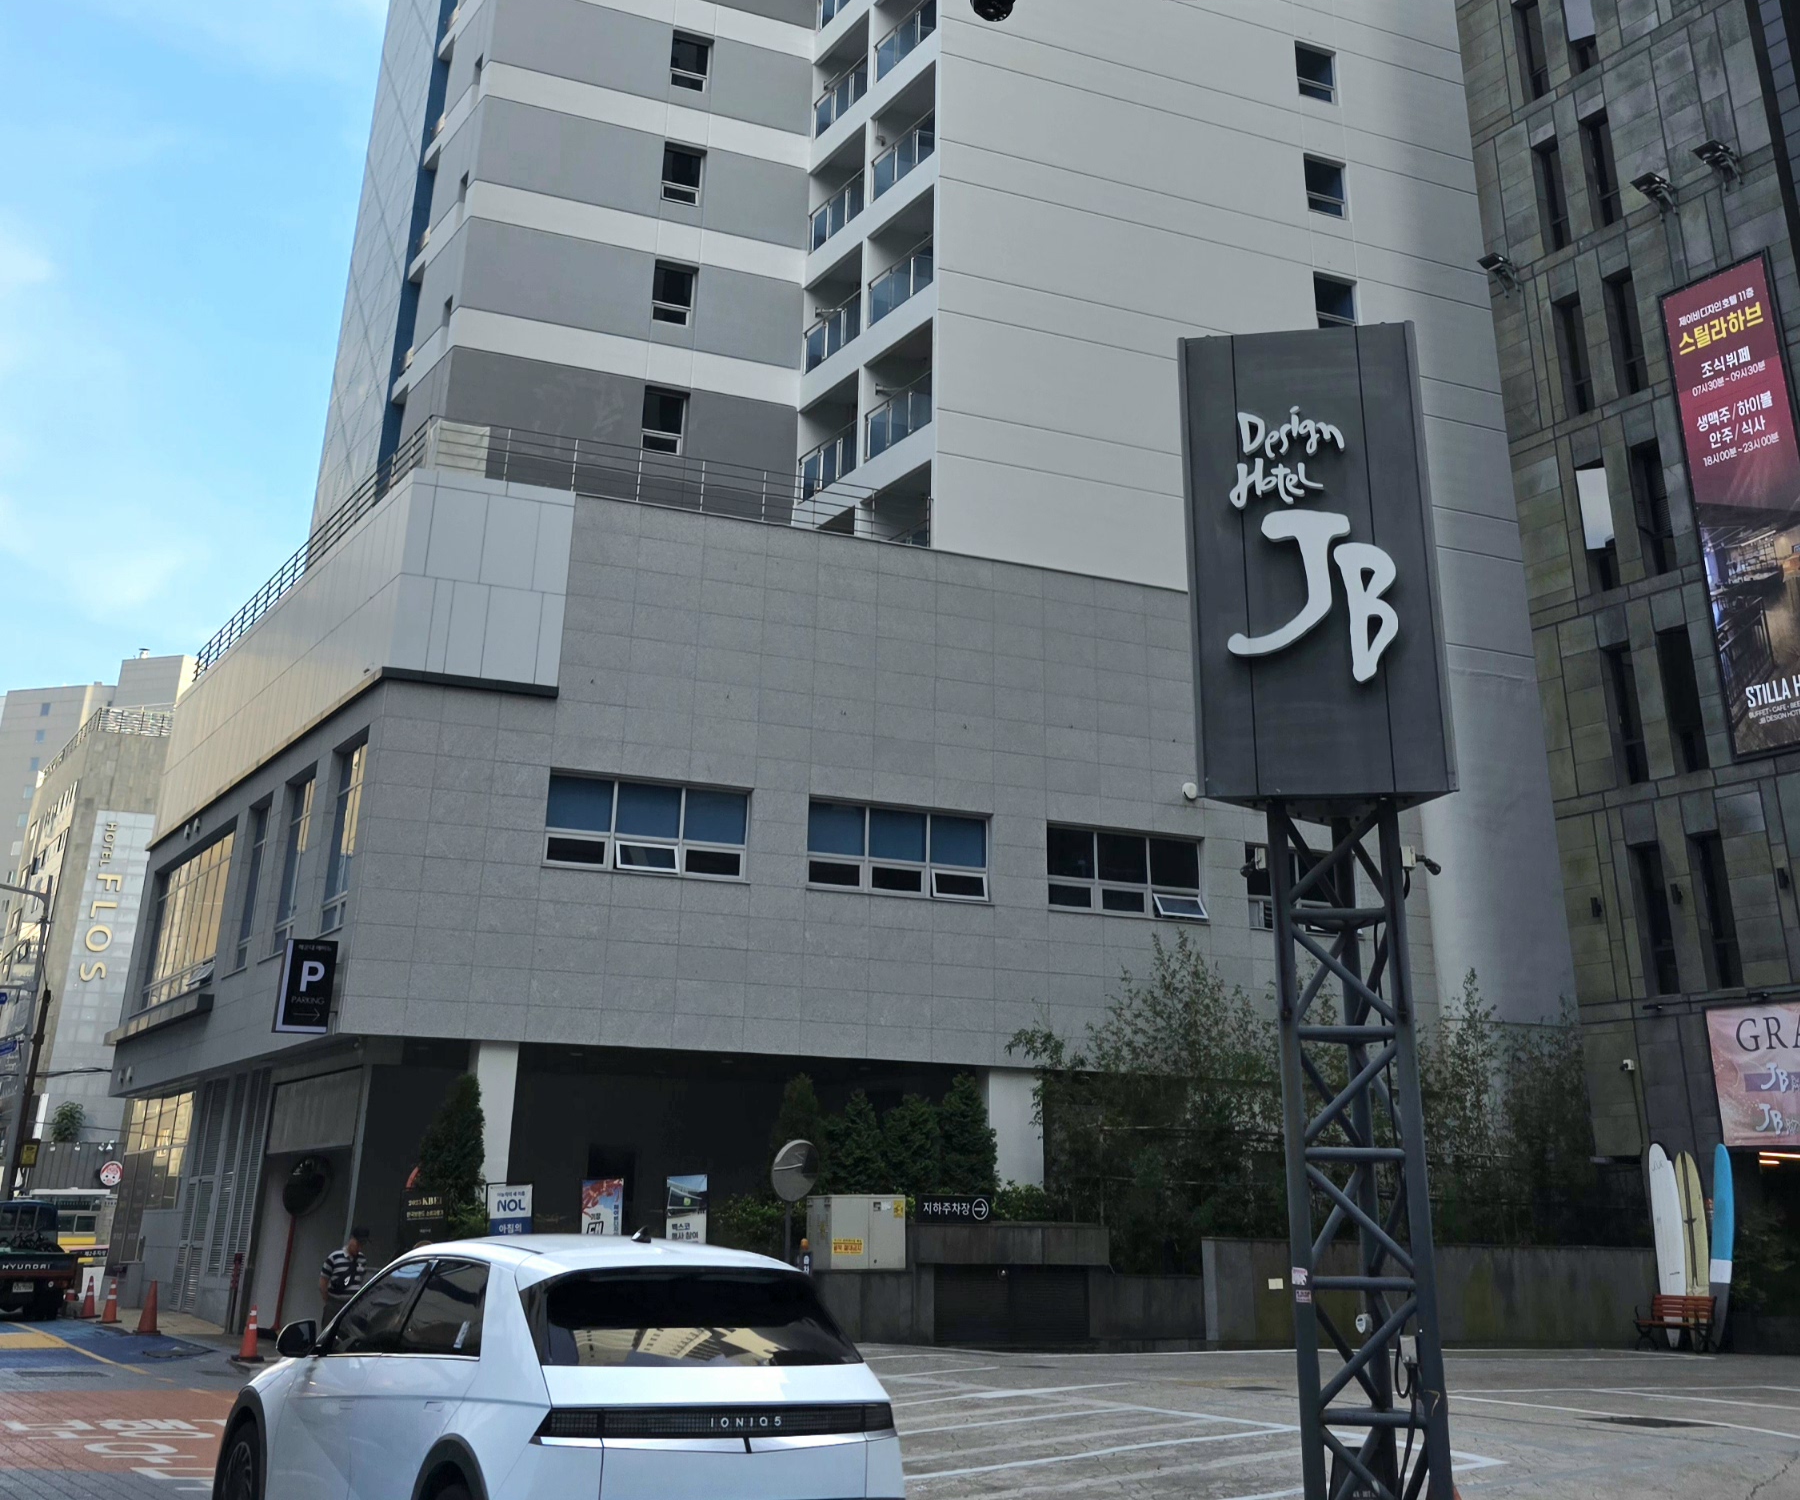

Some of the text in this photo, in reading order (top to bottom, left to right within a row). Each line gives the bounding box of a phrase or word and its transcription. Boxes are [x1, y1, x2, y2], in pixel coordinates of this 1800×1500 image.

[1679, 301, 1764, 355] 스틸라하브
[1237, 406, 1345, 459] Design
[1229, 457, 1325, 510] Hotel
[1227, 508, 1398, 683] JB
[1745, 677, 1791, 708] STILLA
[80, 822, 122, 982] HOTEL FLOS
[299, 961, 325, 992] P
[291, 996, 325, 1005] PARKING
[1736, 1015, 1800, 1052] GR
[1761, 1062, 1789, 1093] JB
[1755, 1103, 1783, 1135] JB
[497, 1199, 526, 1212] NOL
[923, 1202, 970, 1215] 지하주차장
[499, 1223, 522, 1234] 아침의
[2, 1262, 51, 1270] HYUNDAI
[711, 1416, 781, 1428] IONIQ 5
